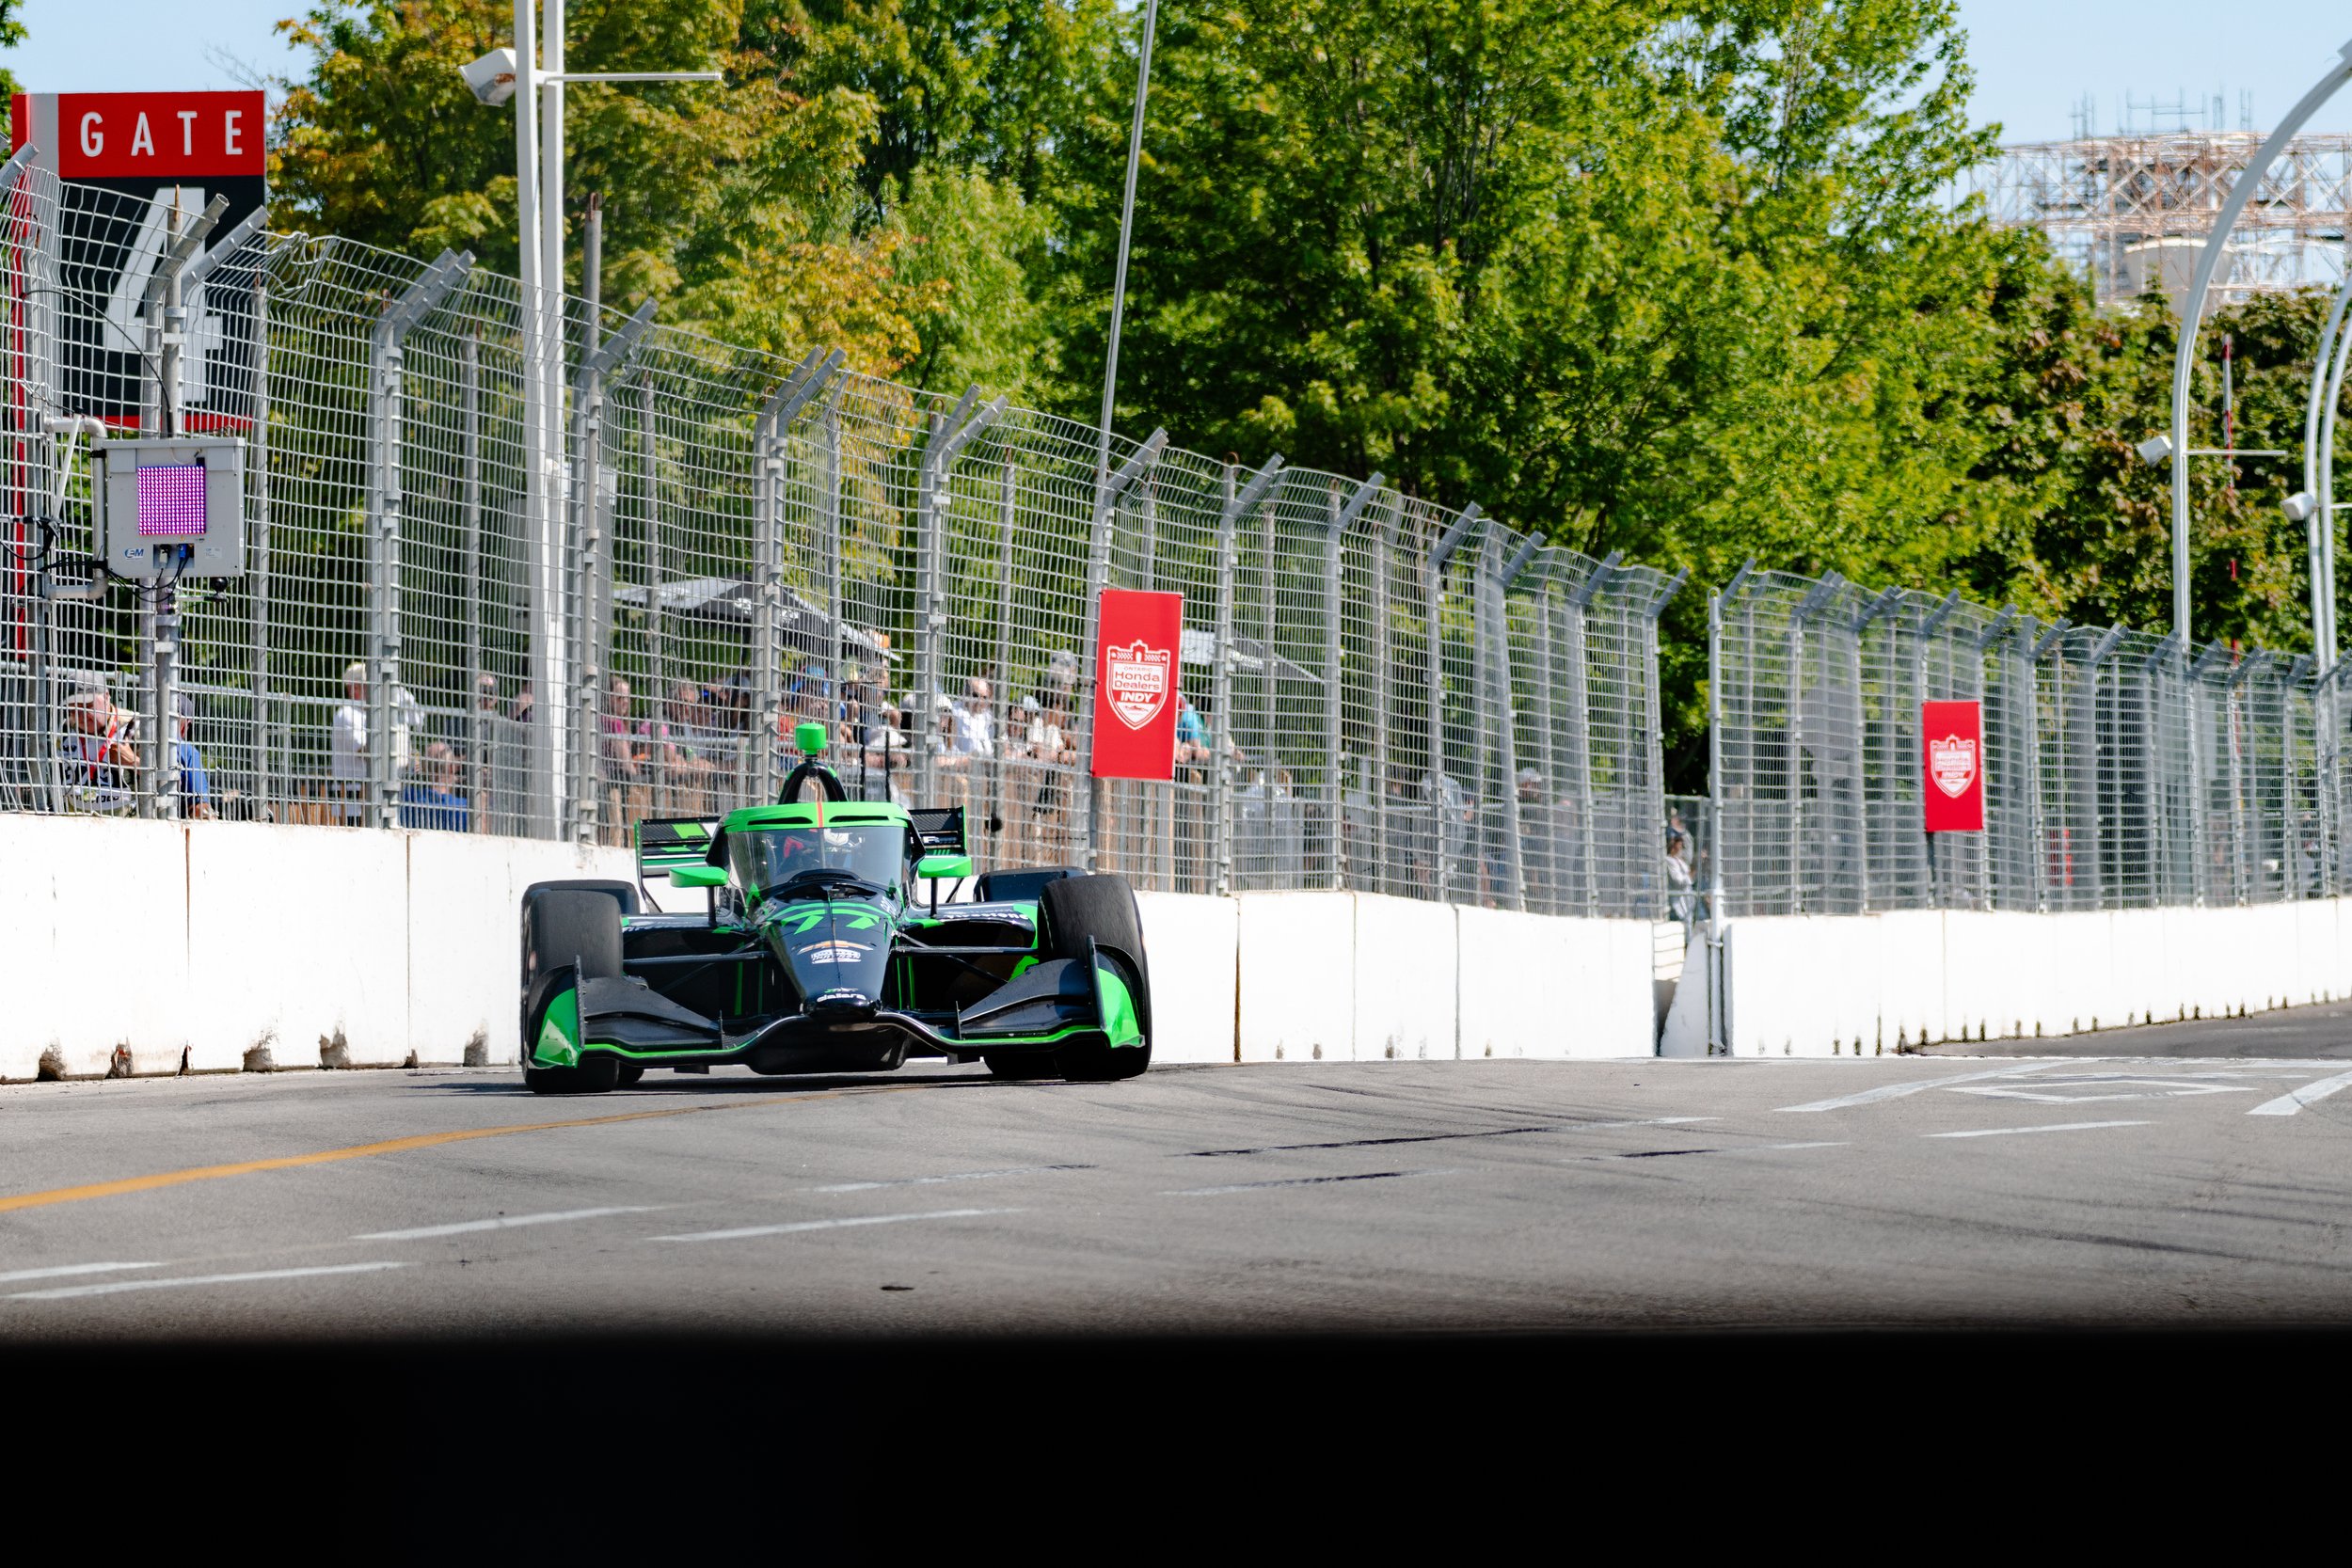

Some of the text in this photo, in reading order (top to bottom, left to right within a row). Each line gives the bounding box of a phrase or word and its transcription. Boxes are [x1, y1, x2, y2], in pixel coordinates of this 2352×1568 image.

[80, 110, 243, 158] GATE
[103, 187, 223, 402] 4
[1115, 671, 1160, 682] Honda
[1114, 680, 1160, 690] Dealers
[1120, 691, 1154, 703] INDY
